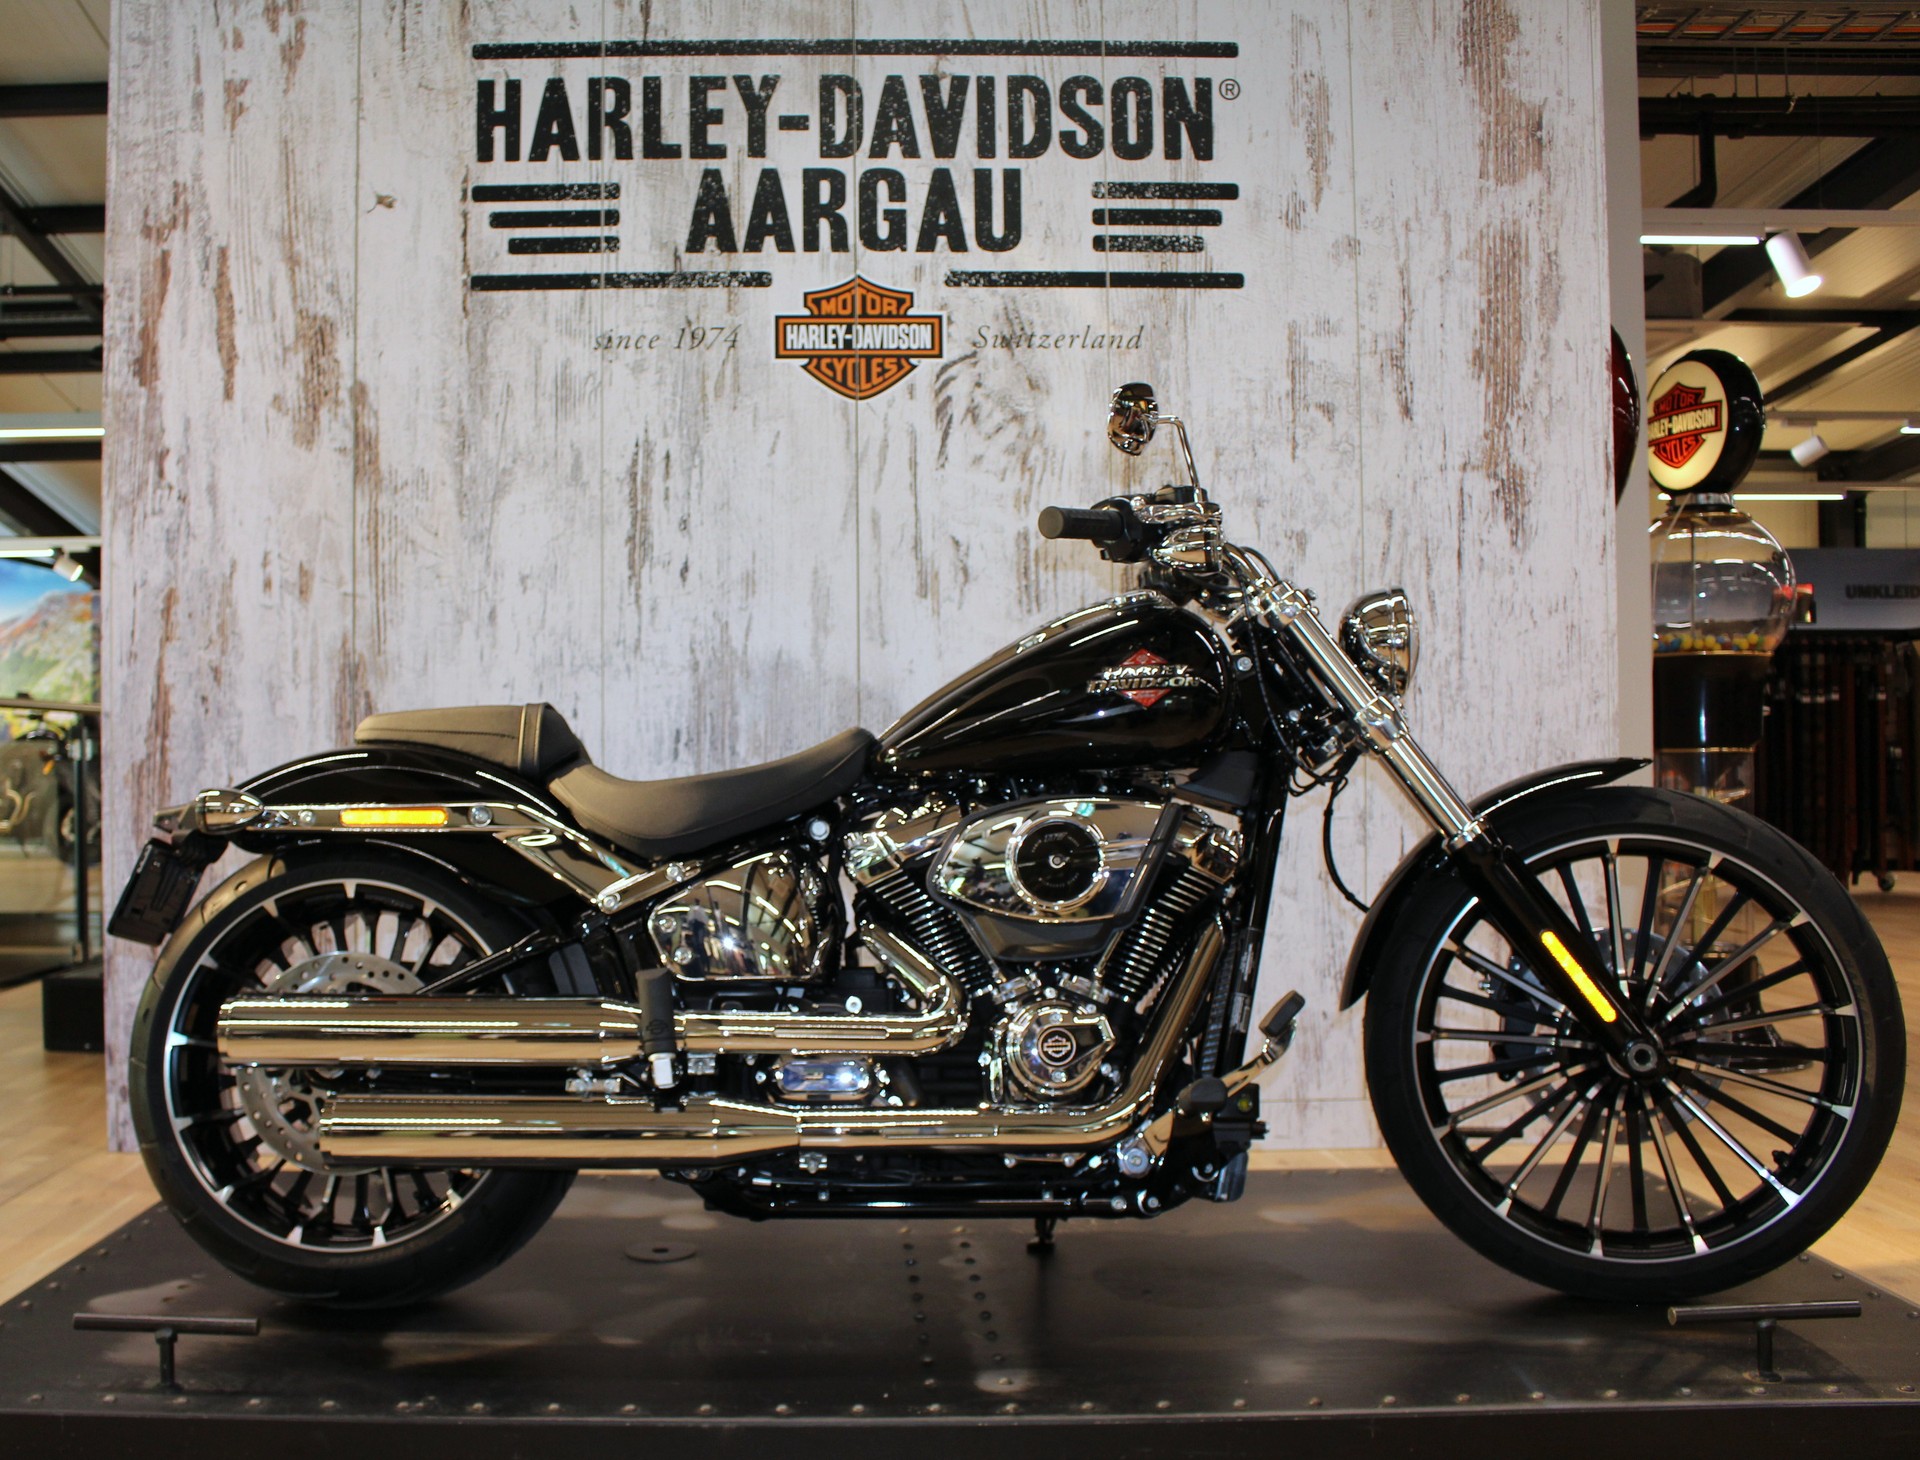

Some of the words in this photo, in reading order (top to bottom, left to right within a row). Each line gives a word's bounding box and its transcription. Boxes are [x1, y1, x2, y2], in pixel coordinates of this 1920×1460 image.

[477, 74, 1214, 162] HARLEY-DAVIDSON
[685, 167, 1022, 253] AARGAU
[820, 288, 899, 316] MOTOR
[593, 328, 661, 351] since
[674, 324, 742, 351] 1974
[785, 323, 933, 350] HARLEY-DAVIDSON
[972, 324, 1145, 350] Switzerland
[819, 357, 899, 391] CYCLES
[1659, 390, 1696, 412] MOTOR
[1659, 436, 1697, 463] CYCLES
[1086, 675, 1201, 694] DAVIDSON
